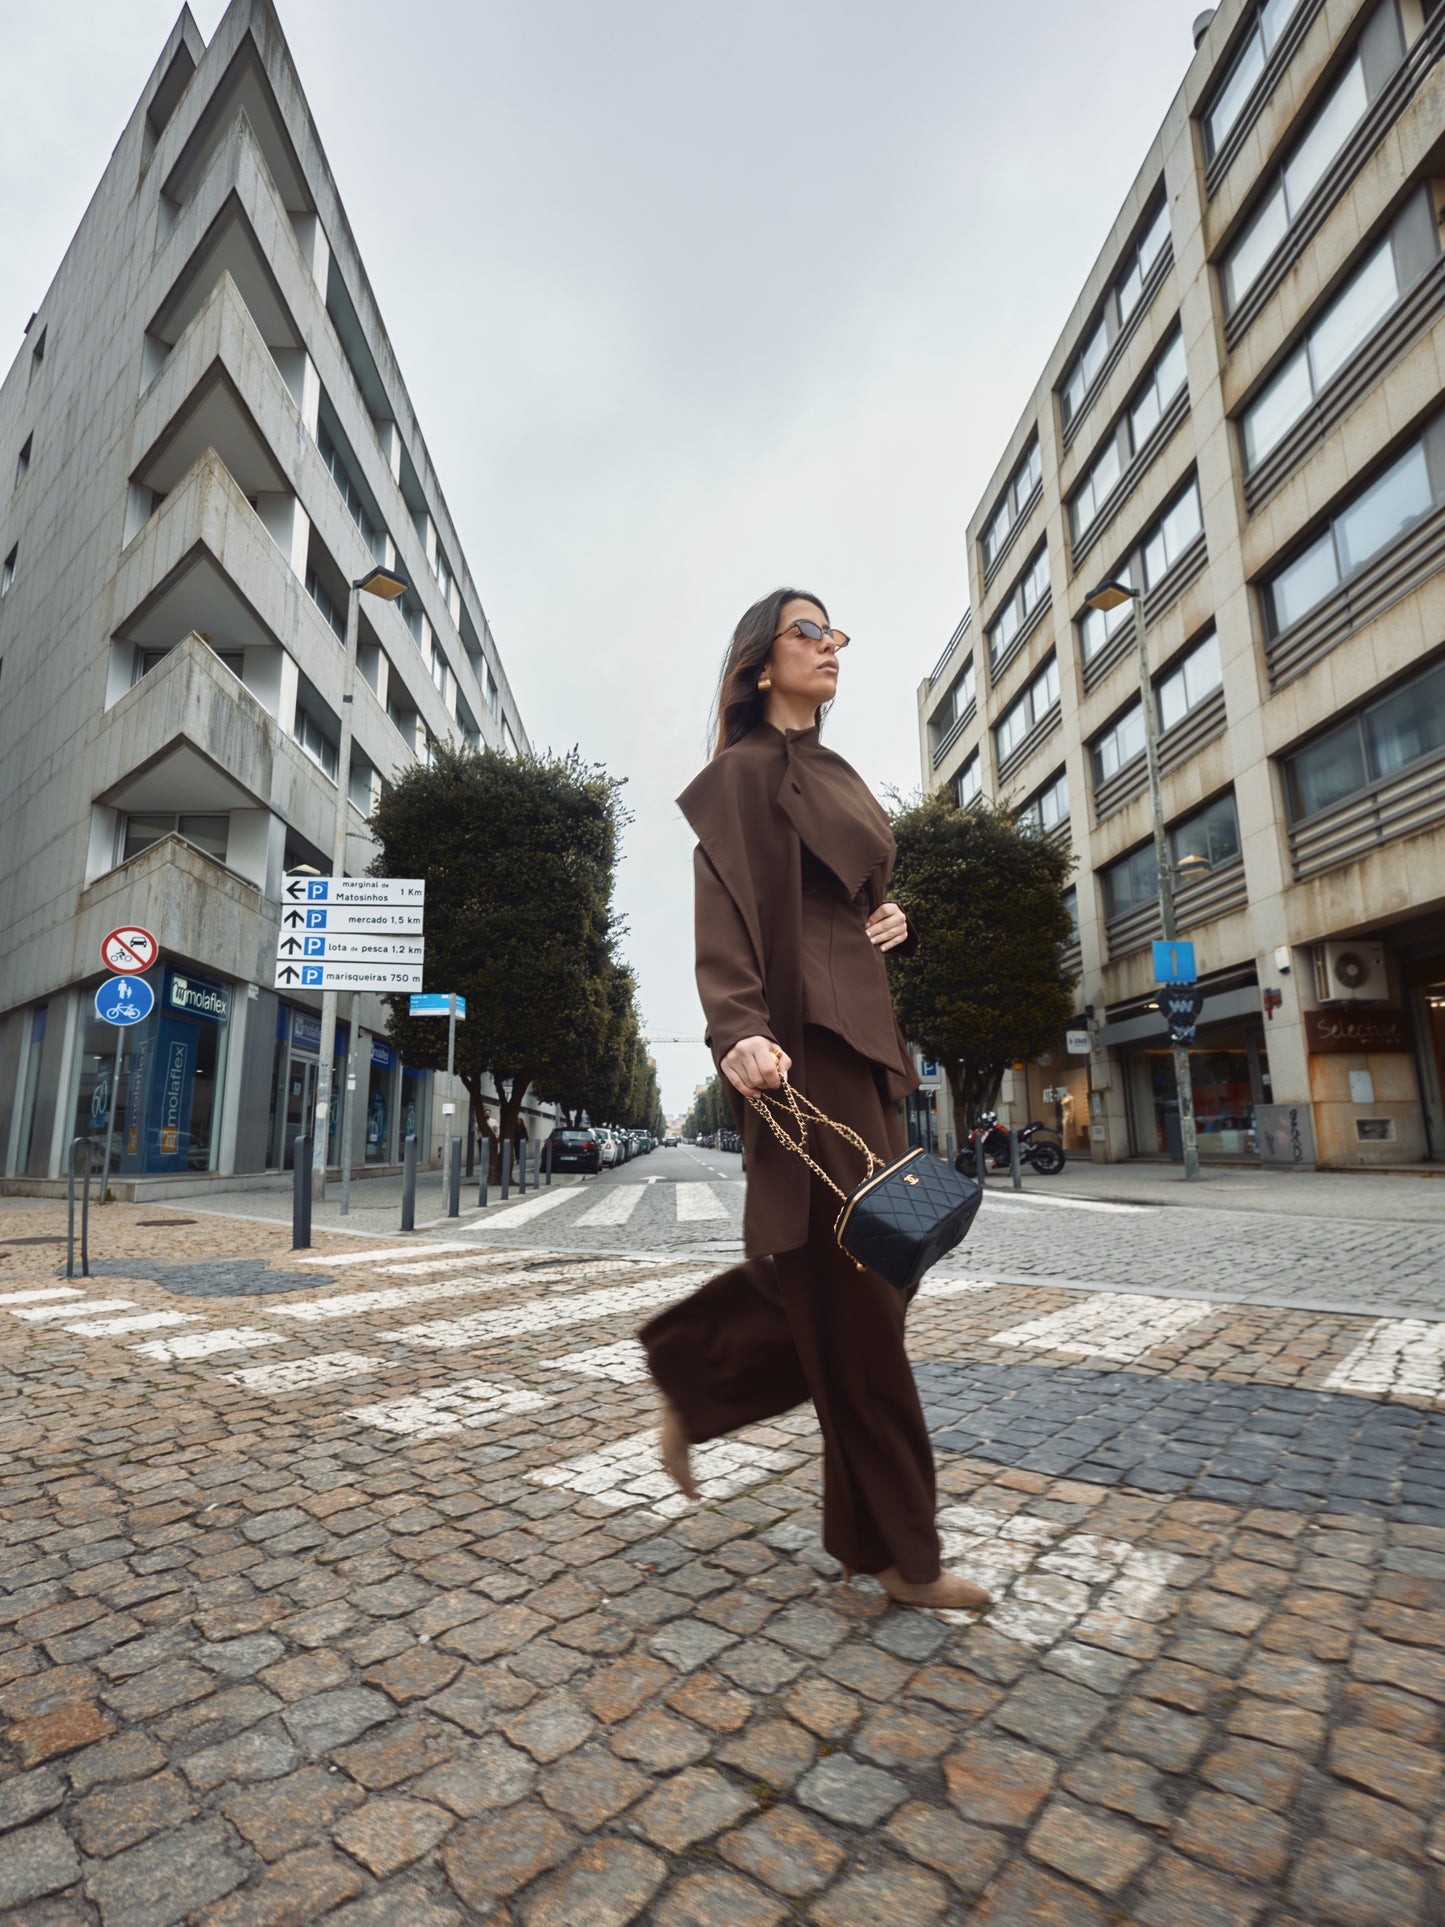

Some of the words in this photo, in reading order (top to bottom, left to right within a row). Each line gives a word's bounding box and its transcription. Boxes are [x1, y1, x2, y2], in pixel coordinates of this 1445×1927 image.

[343, 881, 379, 889] marginal
[336, 893, 389, 902] Matosinhos
[348, 916, 388, 924] mercado
[328, 943, 347, 952] lota
[361, 946, 388, 955] pesca
[408, 946, 422, 954] km
[326, 972, 387, 982] marisqueiras
[390, 974, 409, 983] 750
[185, 989, 227, 1014] molaflex
[167, 1046, 185, 1127] molaflex
